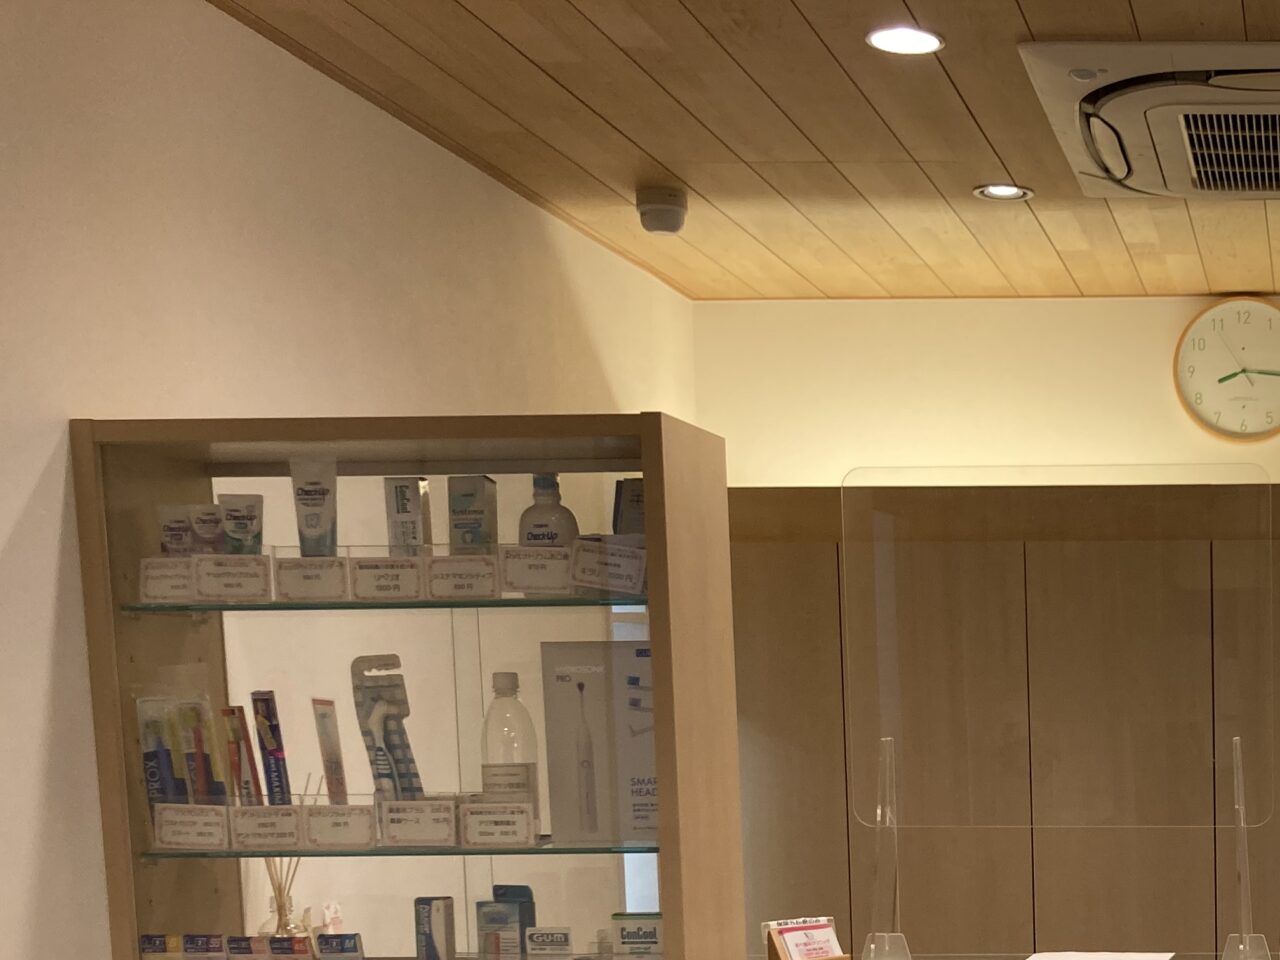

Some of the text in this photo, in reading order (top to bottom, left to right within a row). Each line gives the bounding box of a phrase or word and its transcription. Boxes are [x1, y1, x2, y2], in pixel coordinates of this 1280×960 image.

[1211, 318, 1224, 331] 11
[1236, 311, 1252, 325] 12
[1267, 318, 1273, 331] 1
[1191, 338, 1206, 351] 10
[1187, 366, 1196, 378] 9
[1194, 392, 1203, 405] 8
[1213, 411, 1222, 424] 7
[1265, 411, 1274, 424] 5
[1239, 419, 1248, 432] 6
